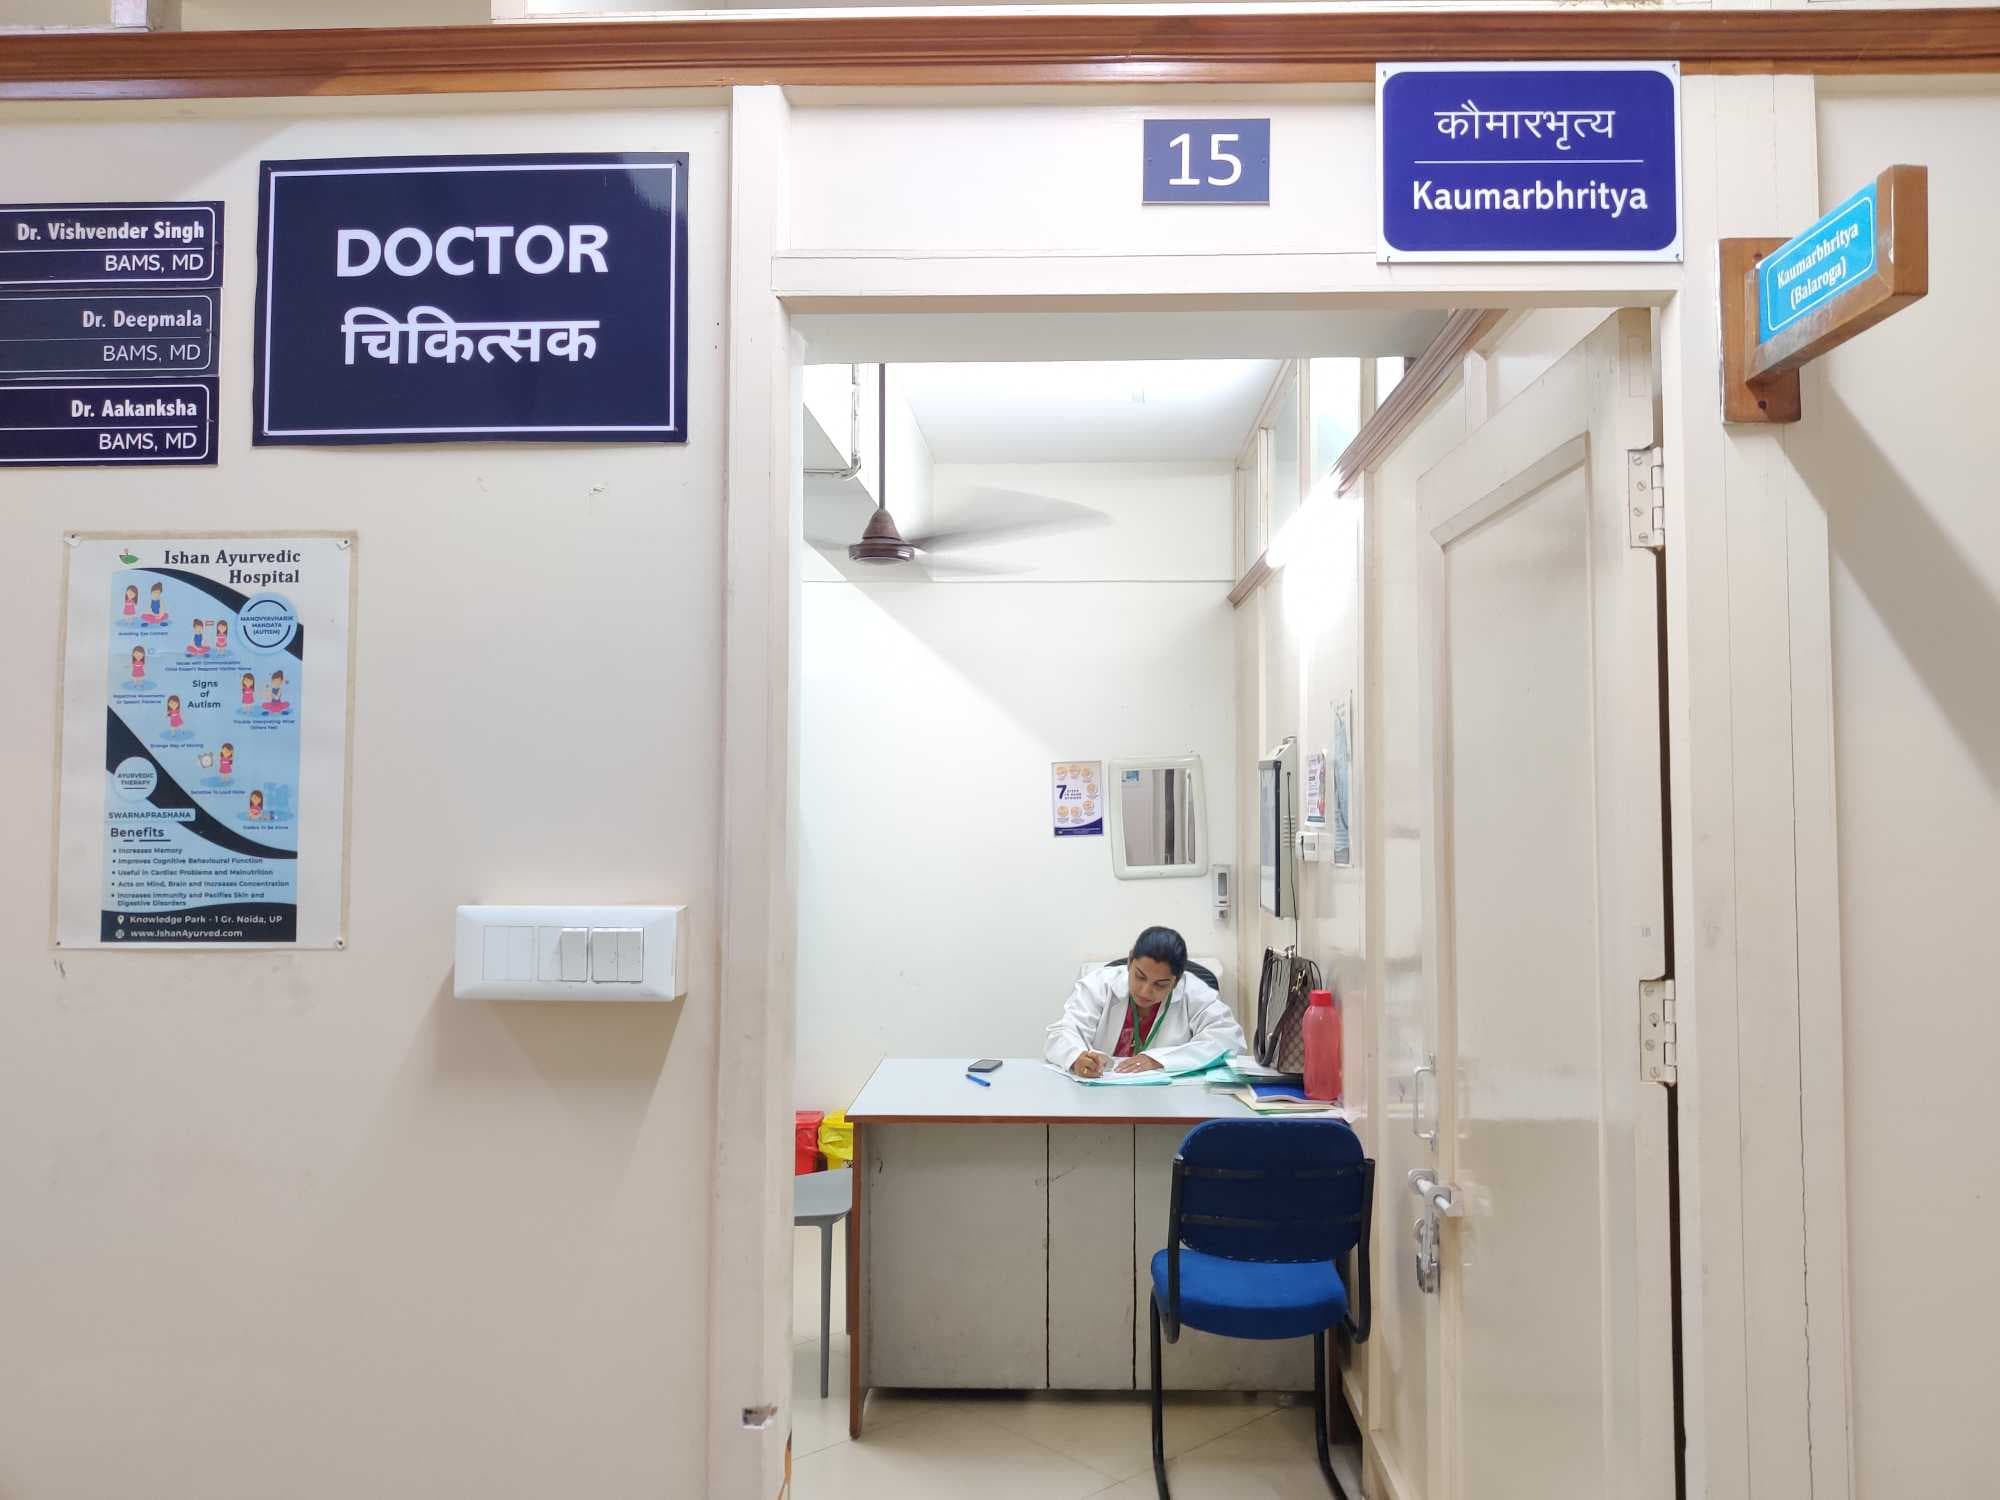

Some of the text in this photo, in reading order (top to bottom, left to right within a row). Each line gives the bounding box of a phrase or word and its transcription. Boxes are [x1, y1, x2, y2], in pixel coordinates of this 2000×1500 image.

[1433, 99, 1616, 150] कौमारभृत्य
[1167, 132, 1243, 187] 15
[1412, 179, 1648, 218] Kaumarbhritya
[17, 221, 205, 243] Dr. Vishvender Singh
[336, 224, 609, 277] DOCTOR
[1777, 223, 1859, 289] Kaumarbhritya
[105, 254, 204, 273] BAMS, MD
[1790, 255, 1847, 310] (Balaroga)
[82, 310, 202, 332] Dr. Deepmala
[340, 305, 600, 365] चिकित्सक
[103, 344, 201, 363] BAMS, MD
[71, 399, 197, 417] Dr. Aakanksha
[99, 432, 197, 452] BAMS, MD
[164, 550, 301, 567] Ishan Ayurvedic
[229, 569, 300, 587] Hospital
[191, 679, 219, 690] Signs
[199, 690, 210, 698] of
[187, 700, 221, 709] Autism
[1056, 784, 1067, 800] 7
[110, 827, 165, 838] Benefits
[129, 915, 183, 926] Knowledge
[185, 915, 206, 924] Park
[236, 915, 267, 926] Noida,
[269, 915, 283, 924] UP
[130, 929, 243, 939] www.IshanAyurved.com
